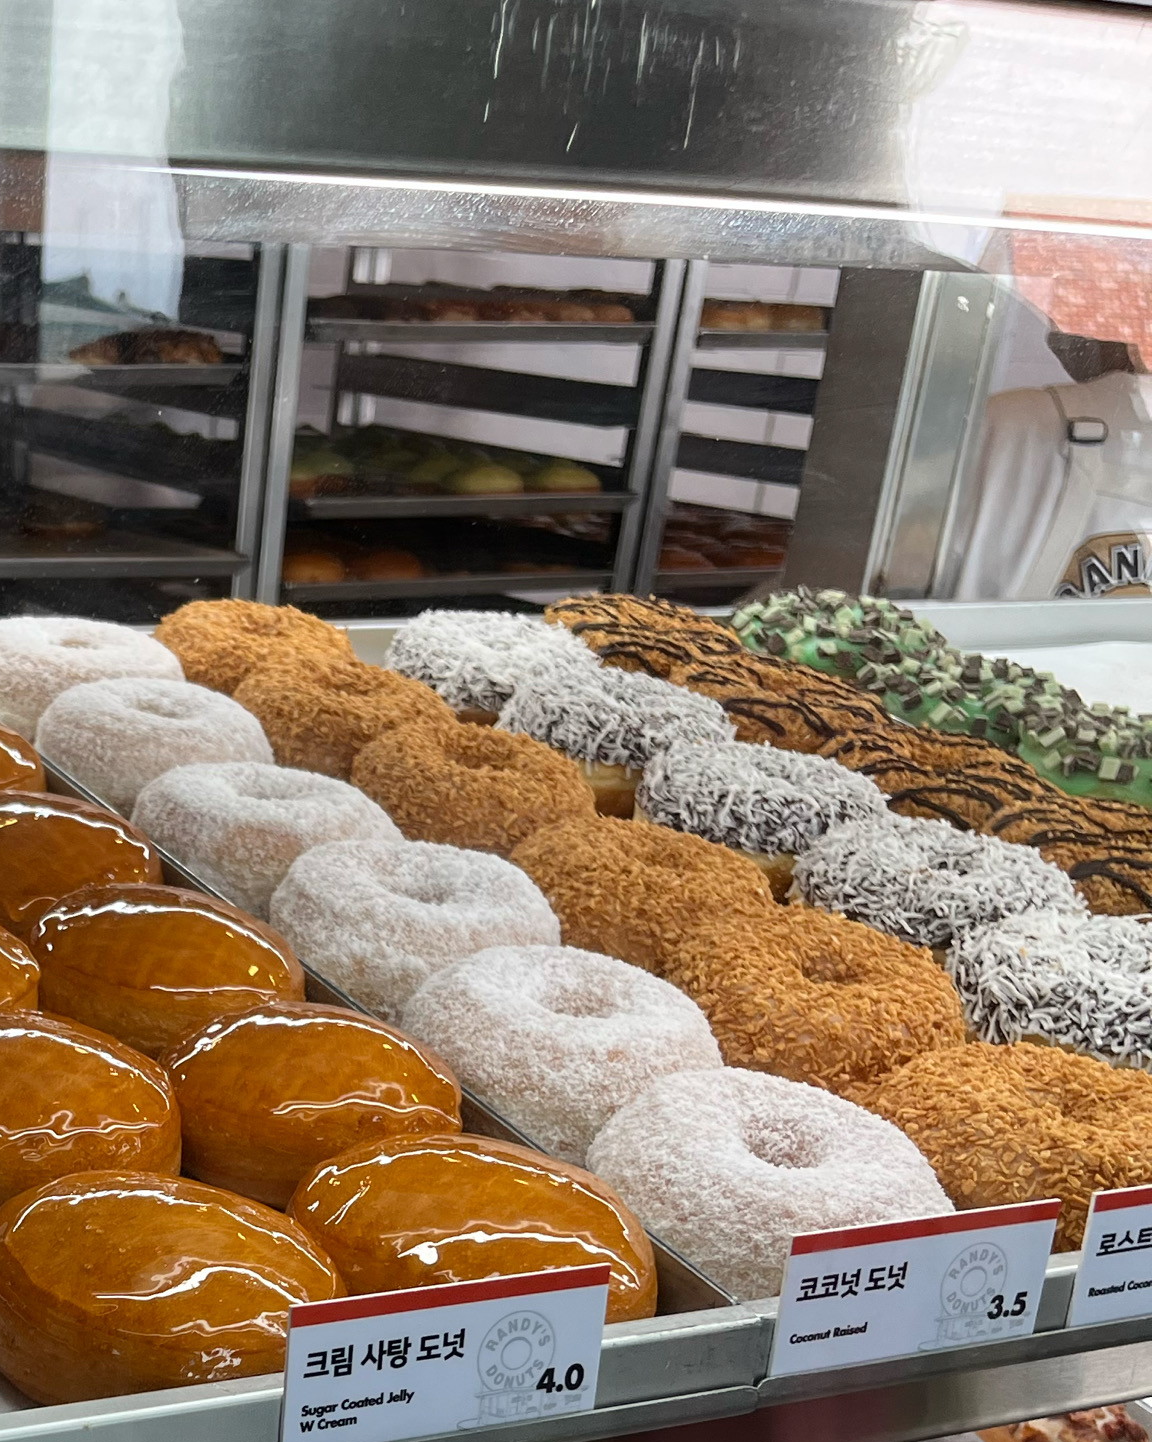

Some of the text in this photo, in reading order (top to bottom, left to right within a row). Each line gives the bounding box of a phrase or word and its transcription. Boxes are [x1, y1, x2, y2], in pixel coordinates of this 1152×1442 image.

[949, 1248, 1004, 1280] RANDY'S
[796, 1261, 908, 1302] 코코넛 도넛
[1088, 1281, 1126, 1297] Roasted
[946, 1286, 996, 1316] DONUTS
[987, 1291, 1027, 1320] 3.5
[486, 1317, 551, 1351] RANDY'S
[789, 1322, 868, 1345] Coconut Raised
[303, 1328, 466, 1378] 크림 사탕 도넛
[485, 1358, 544, 1388] DONUTS
[536, 1363, 585, 1394] 4.0
[301, 1389, 415, 1418] Sugar Coated Jelly
[300, 1415, 357, 1433] W Cream
